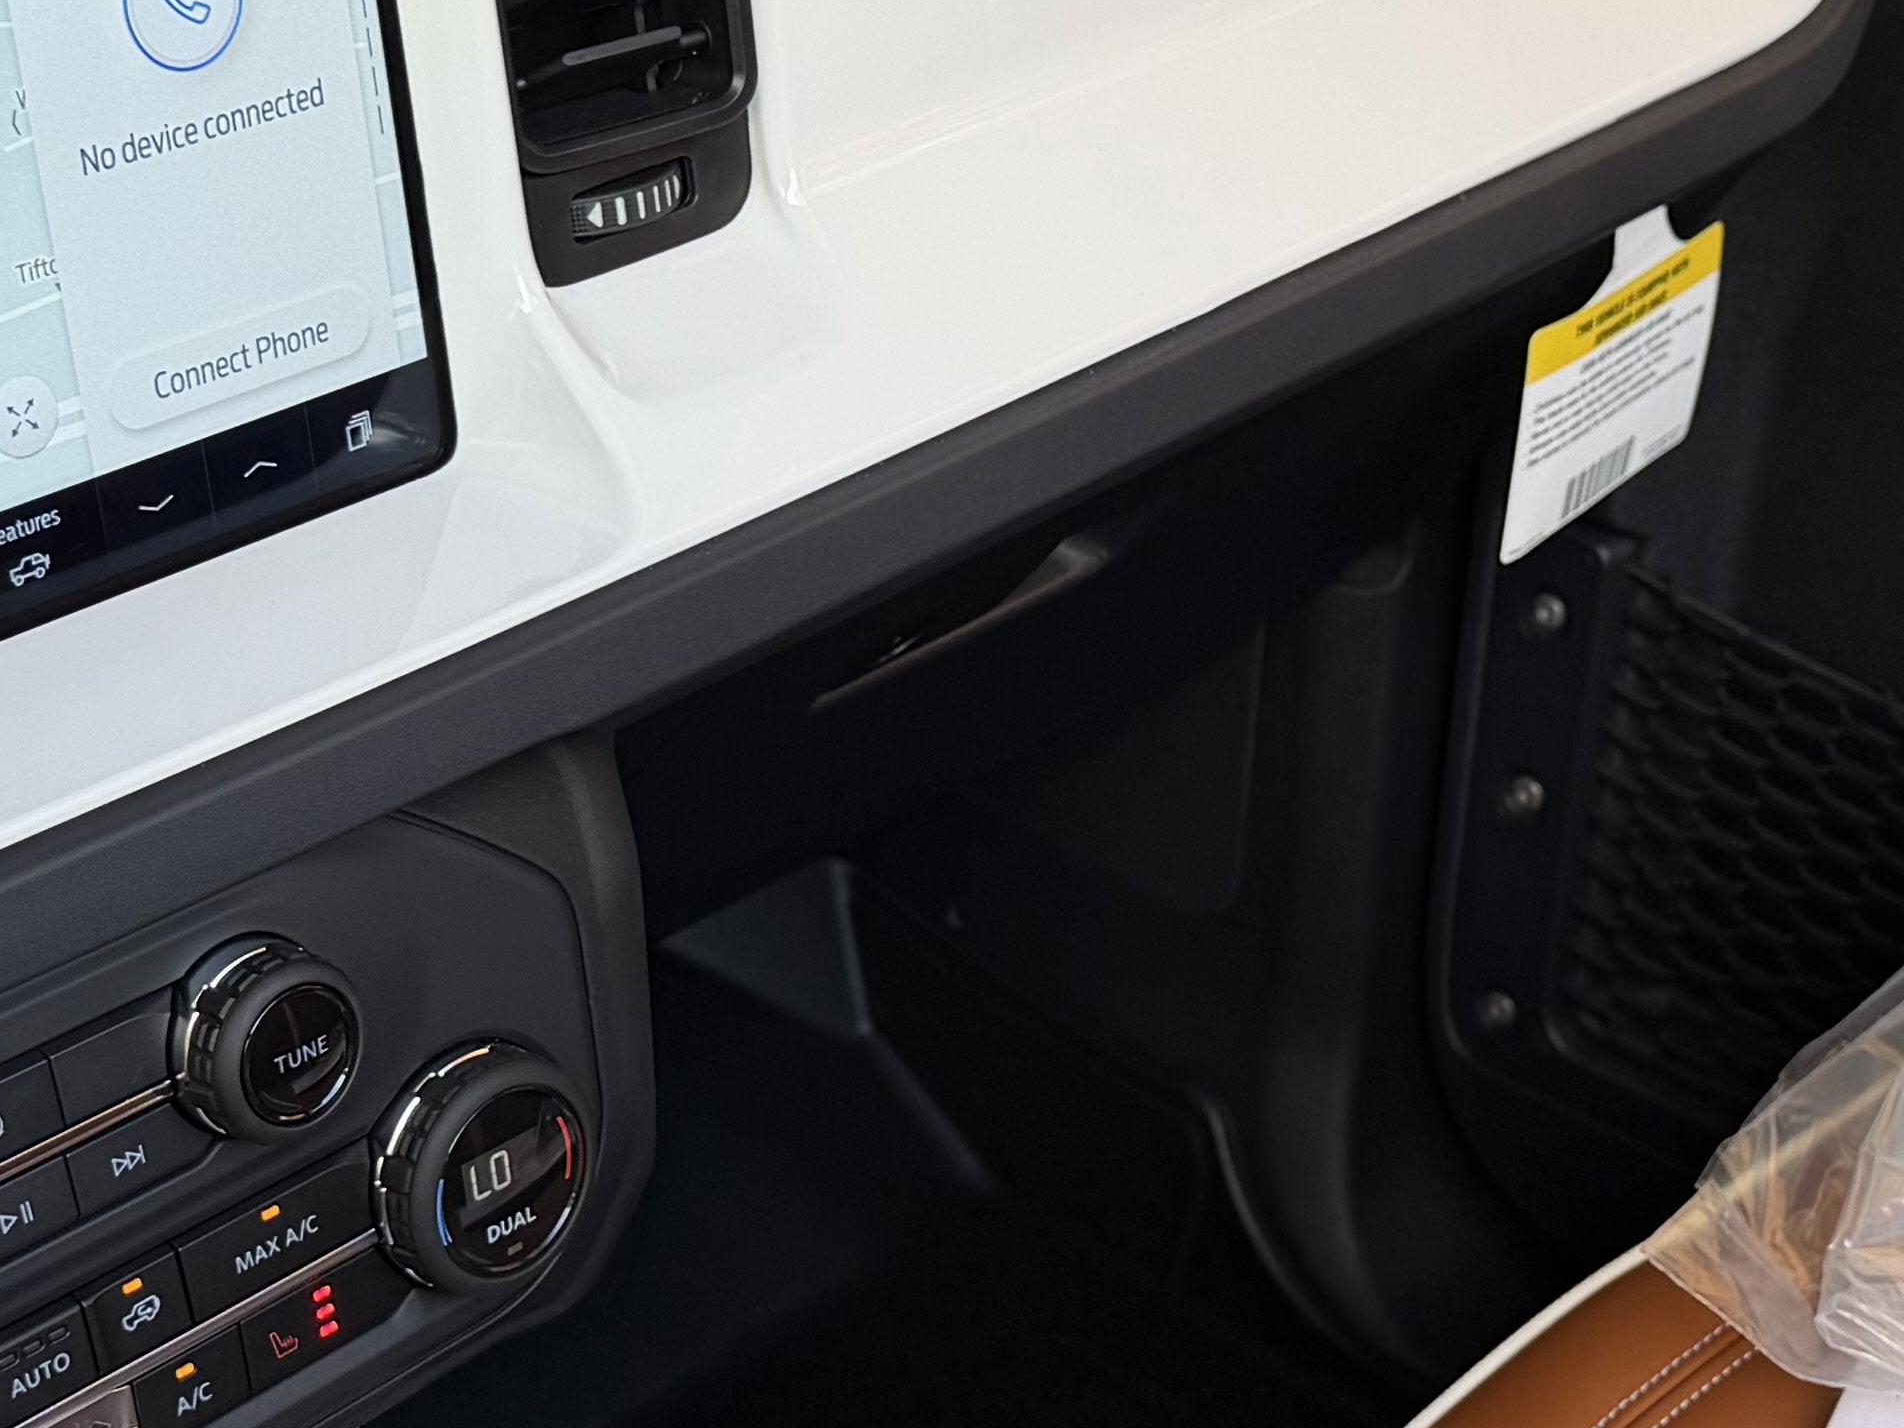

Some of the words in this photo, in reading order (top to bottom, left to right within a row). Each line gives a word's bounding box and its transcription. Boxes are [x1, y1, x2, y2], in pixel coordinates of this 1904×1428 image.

[80, 142, 117, 176] No
[121, 118, 197, 164] device
[202, 78, 325, 140] connected
[153, 345, 252, 401] Connect
[254, 318, 330, 373] Phone
[274, 1035, 329, 1073] TUNE
[235, 1234, 279, 1274] MAX
[283, 1213, 320, 1249] A/C
[486, 1205, 536, 1244] DUAL
[10, 1354, 71, 1397] AUTO
[176, 1382, 214, 1416] A/C
